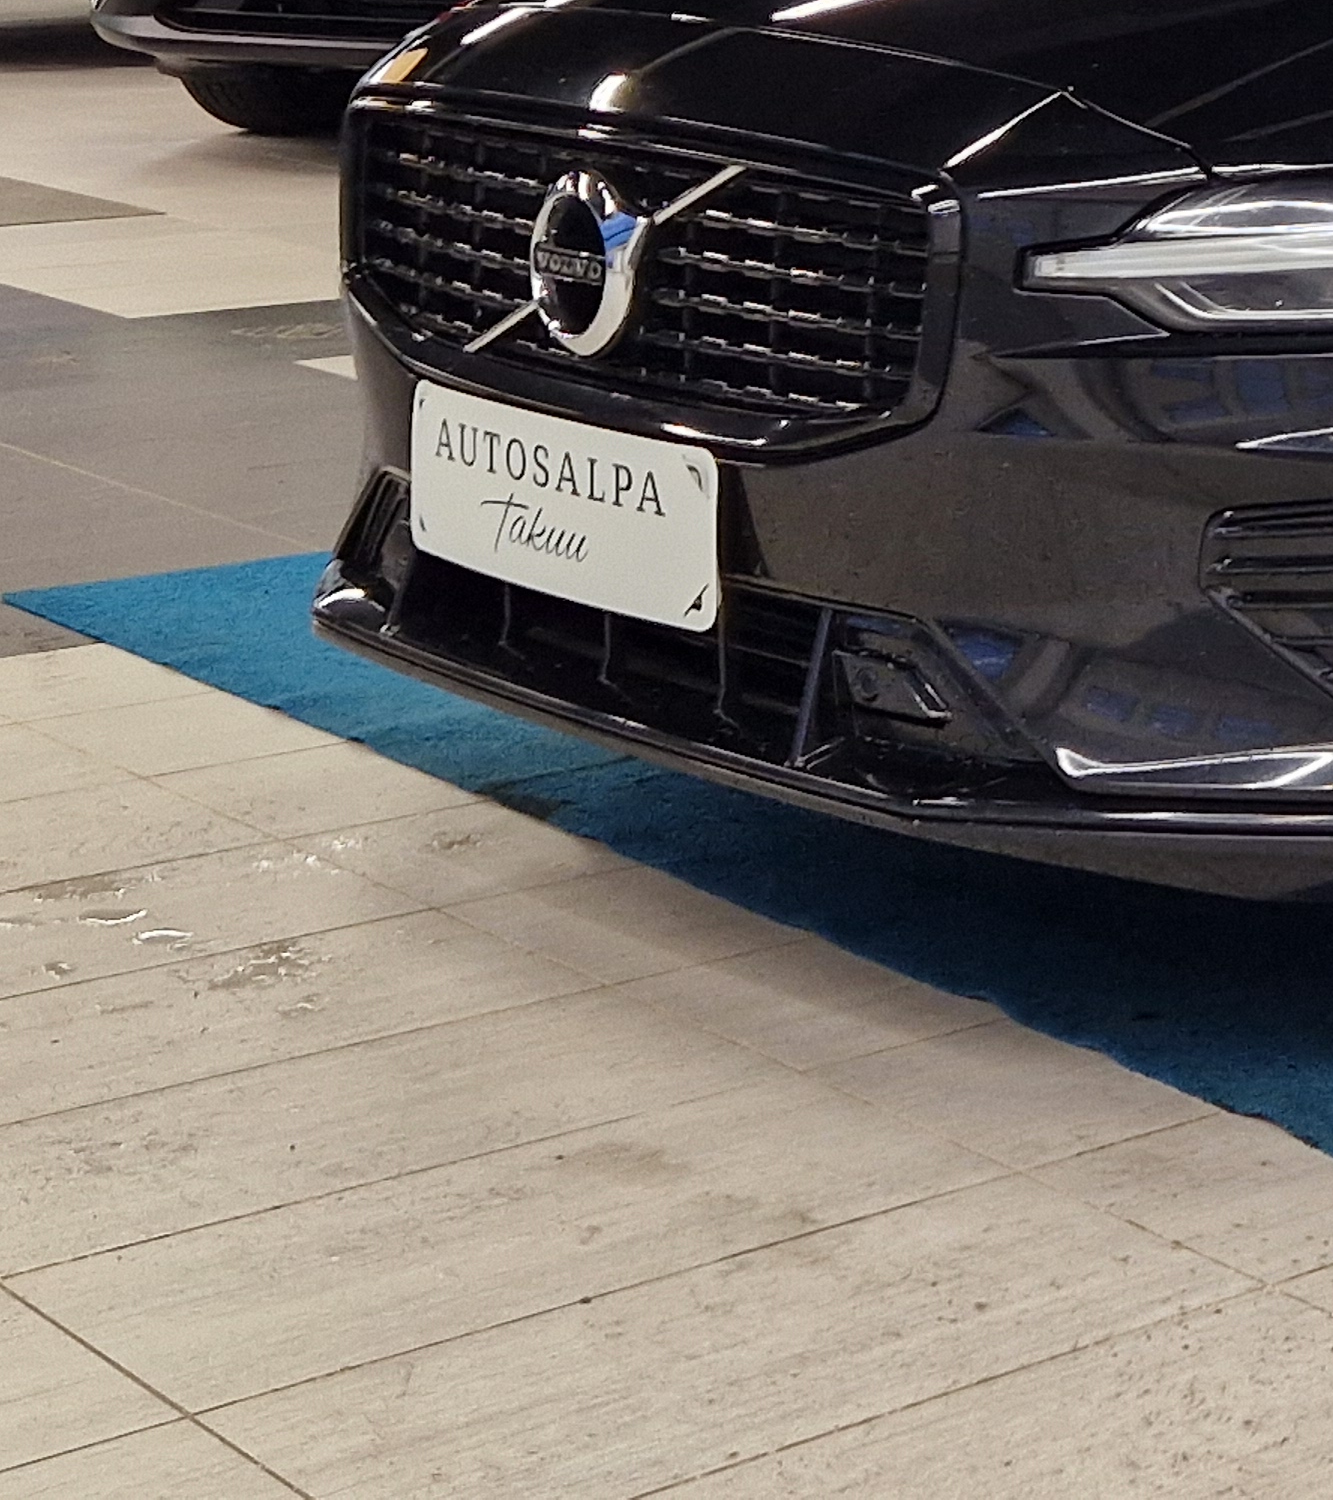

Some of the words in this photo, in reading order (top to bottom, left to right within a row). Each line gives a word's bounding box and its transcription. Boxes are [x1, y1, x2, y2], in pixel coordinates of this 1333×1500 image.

[536, 250, 603, 280] VOLVO
[435, 418, 667, 518] AUTOSALPA
[480, 492, 589, 563] Takuu
